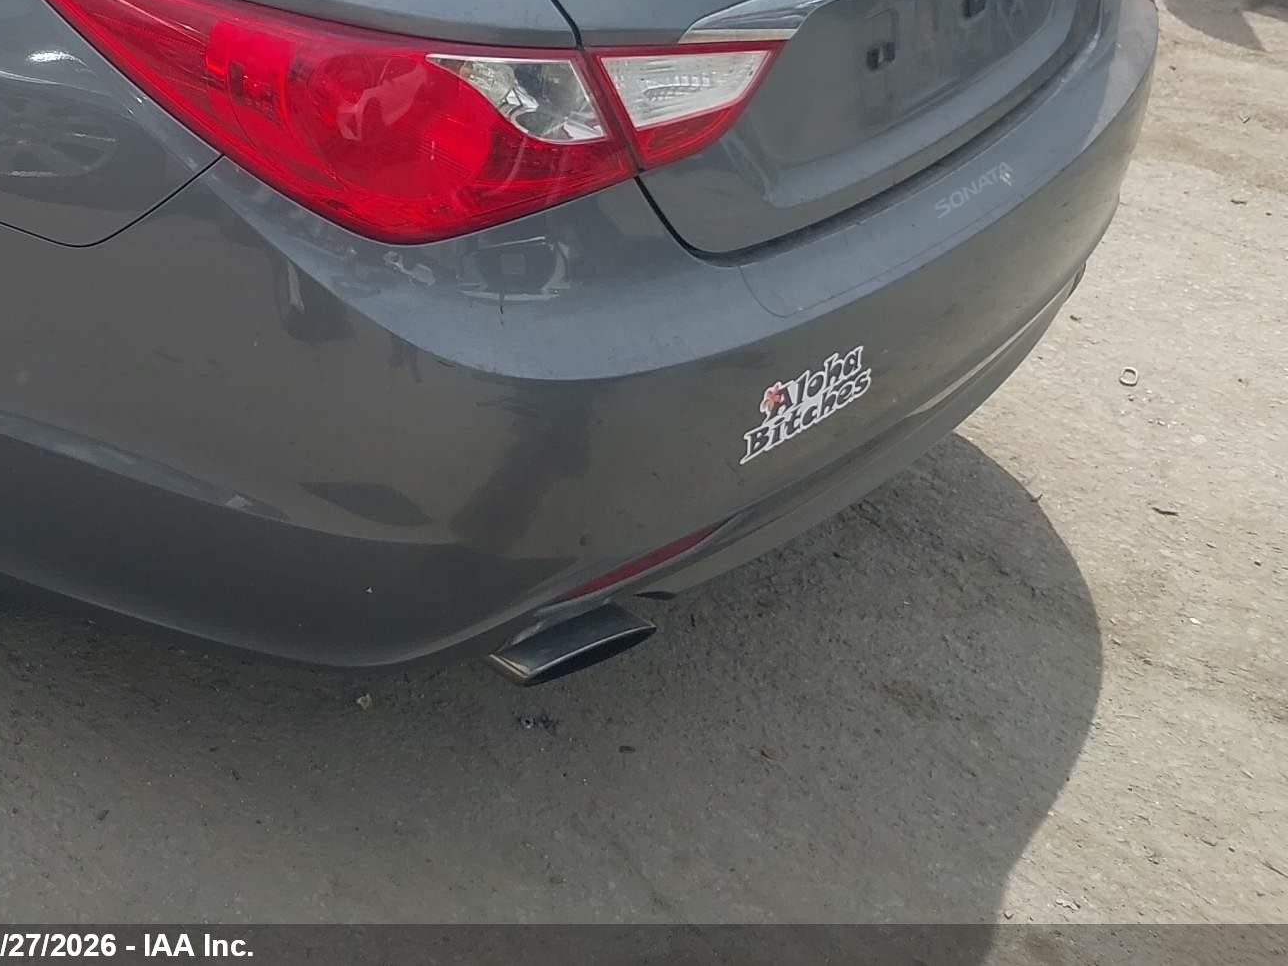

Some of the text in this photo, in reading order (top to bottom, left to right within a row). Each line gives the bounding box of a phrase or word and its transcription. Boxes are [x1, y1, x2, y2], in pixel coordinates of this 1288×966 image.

[934, 161, 1014, 219] SONATA
[739, 368, 872, 465] Bitches
[762, 345, 864, 427] Aloha
